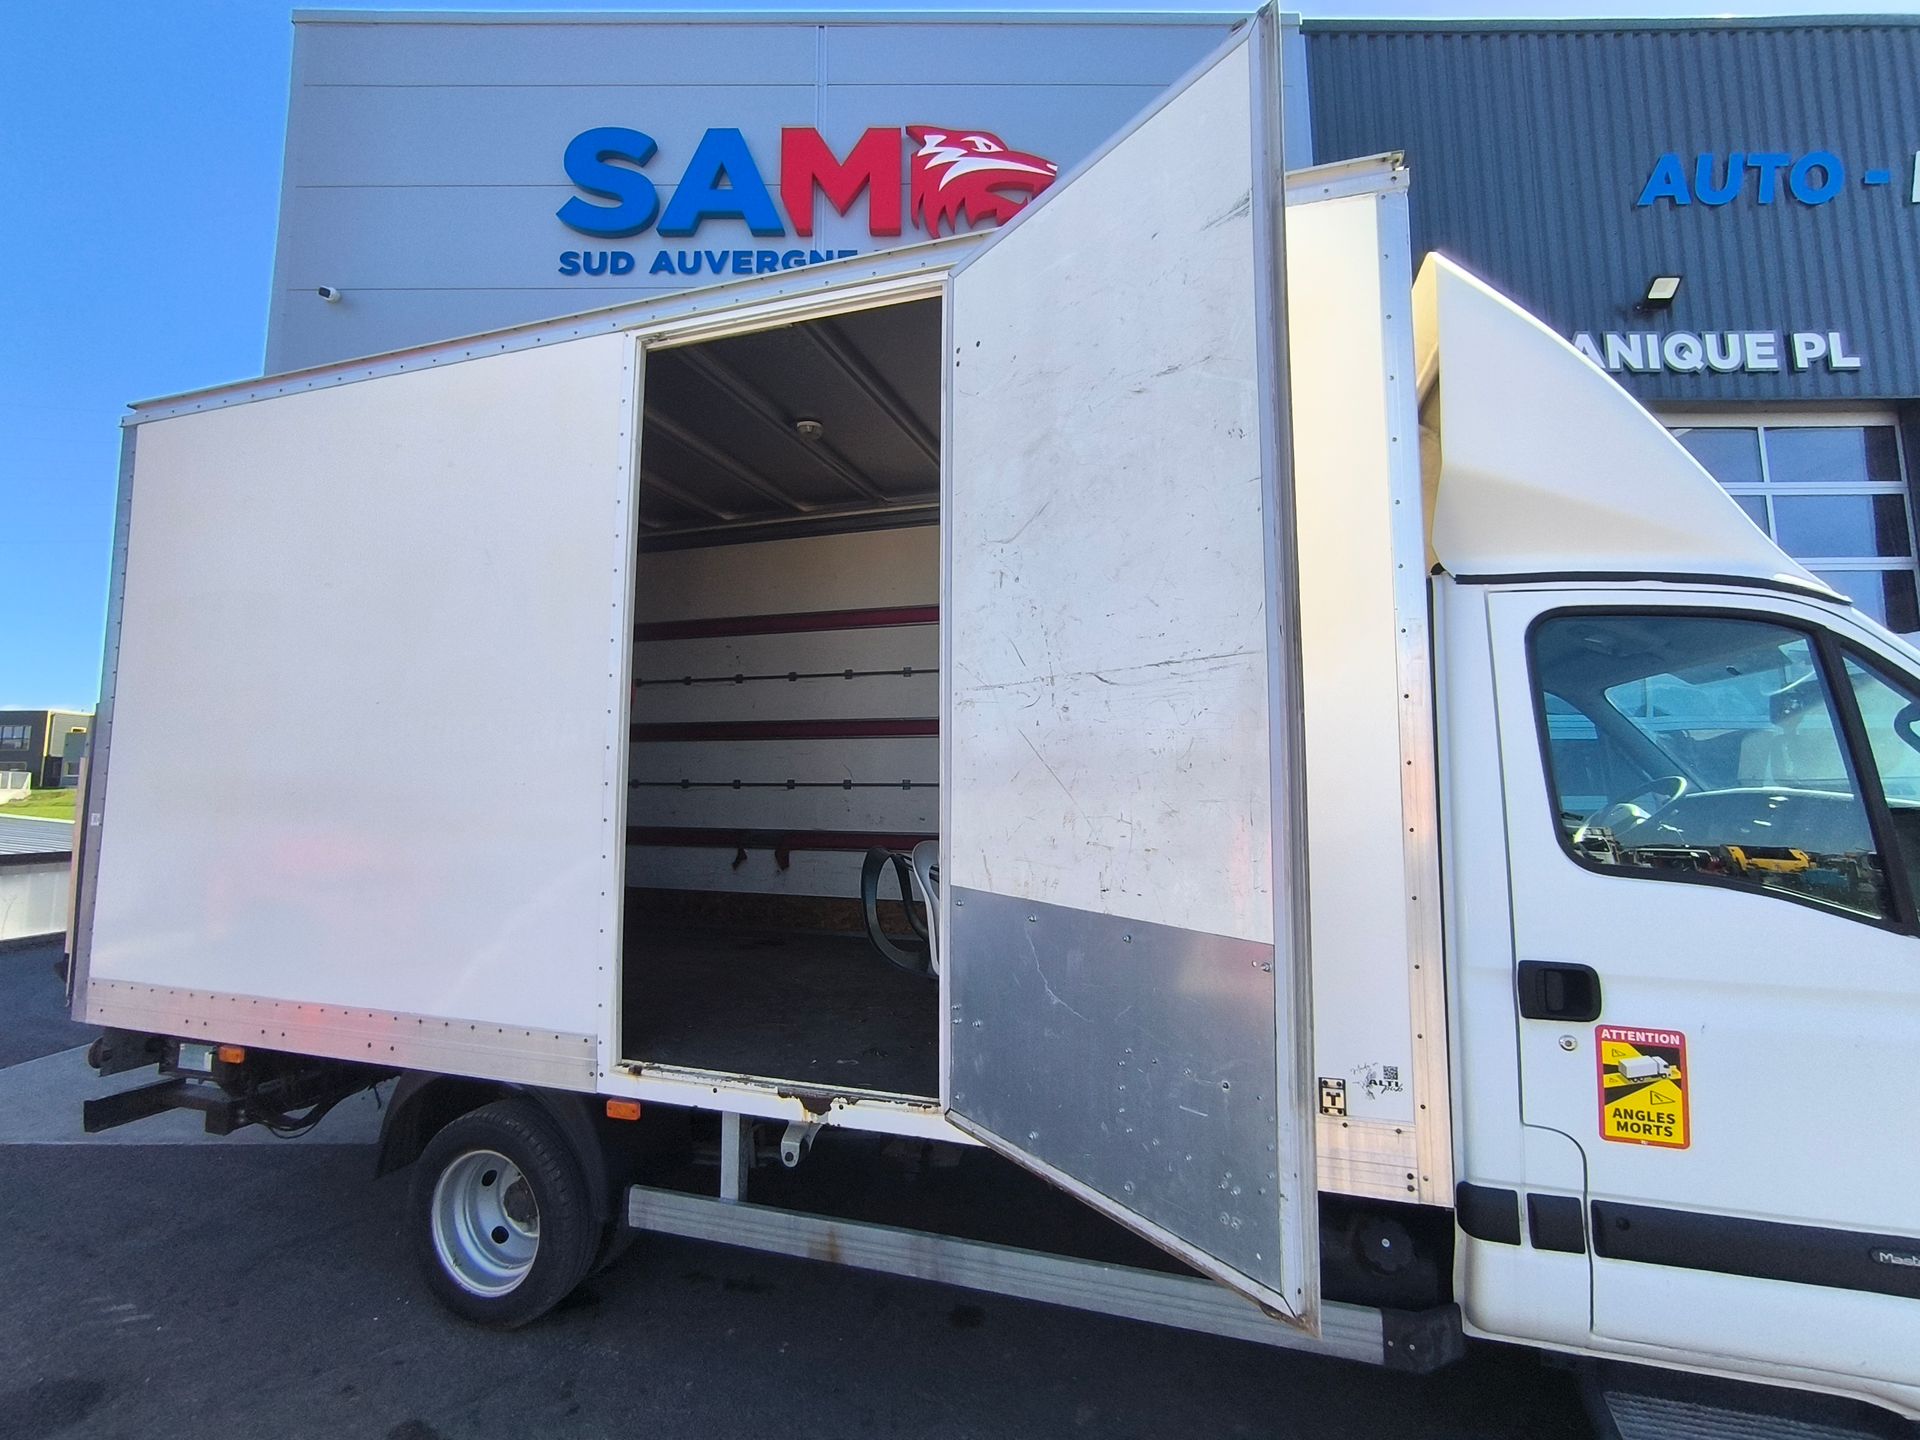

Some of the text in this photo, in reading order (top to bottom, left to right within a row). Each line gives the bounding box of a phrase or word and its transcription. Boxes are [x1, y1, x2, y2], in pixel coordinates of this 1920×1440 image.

[556, 126, 903, 239] SAM
[1637, 151, 1846, 206] AUTO
[558, 250, 636, 276] SUD
[1791, 331, 1861, 371] PL
[1601, 1029, 1680, 1045] ATTENTION
[1612, 1107, 1676, 1125] ANGLES
[1616, 1120, 1673, 1137] MORTS
